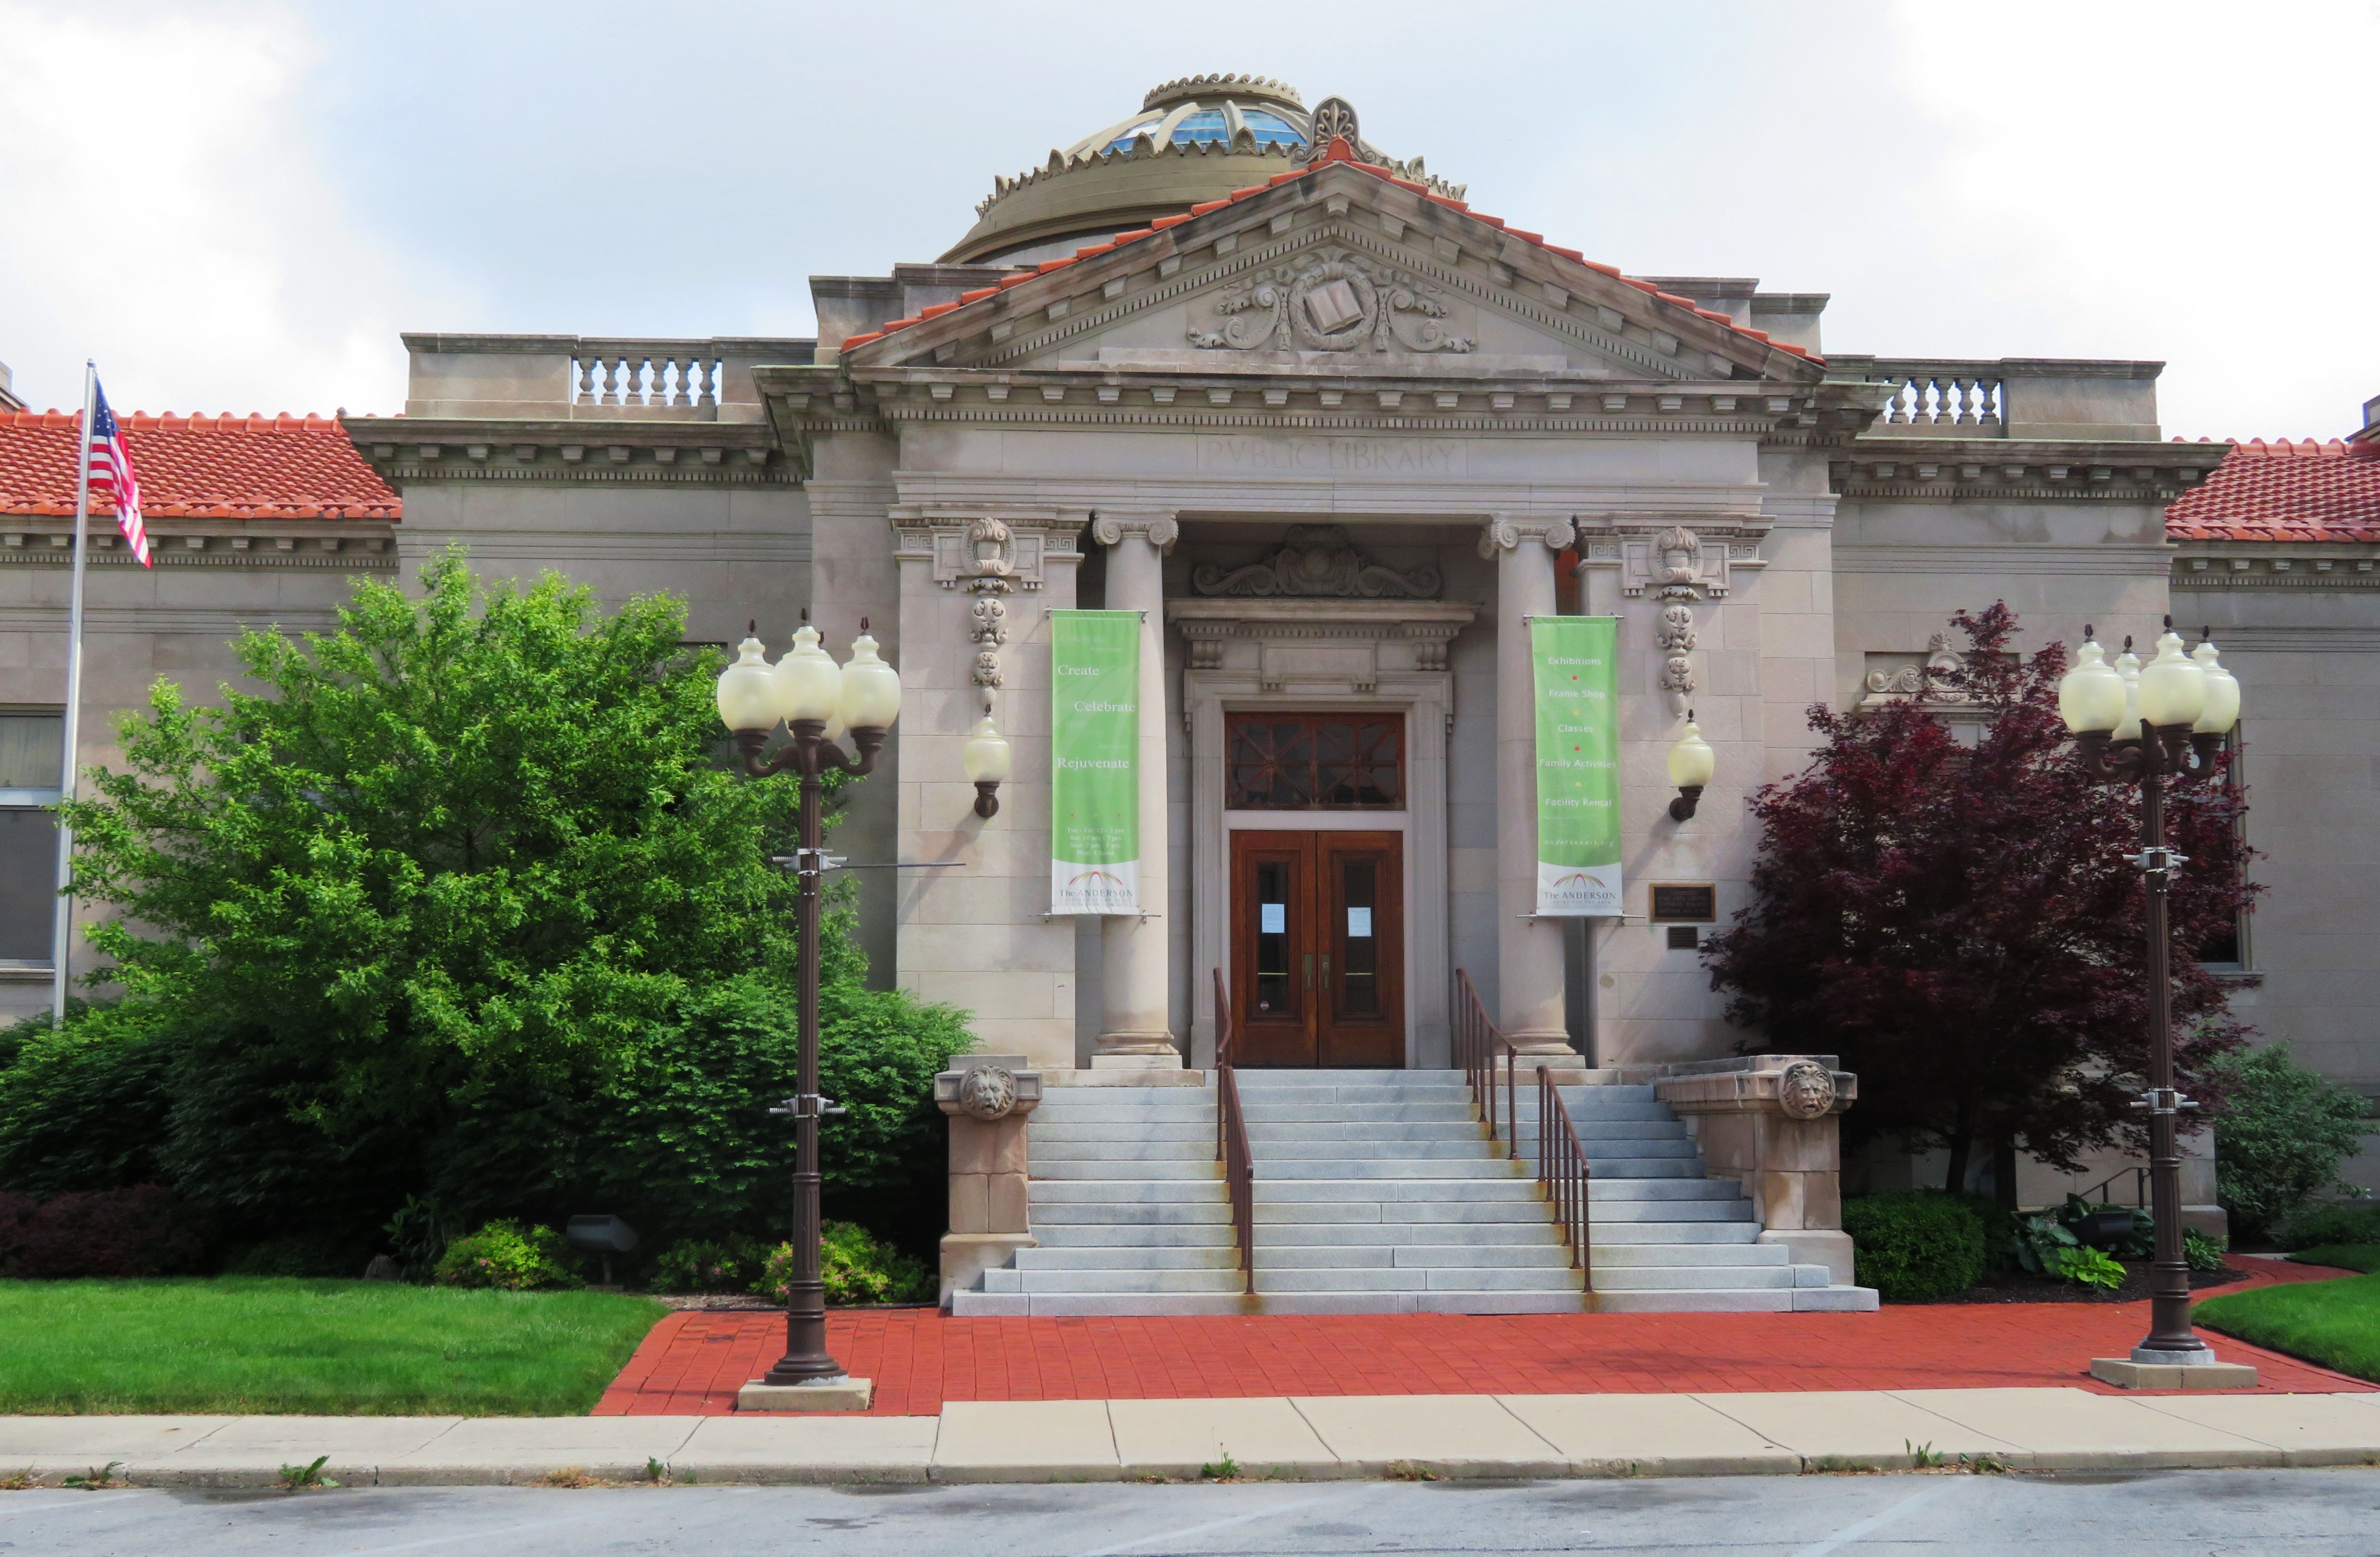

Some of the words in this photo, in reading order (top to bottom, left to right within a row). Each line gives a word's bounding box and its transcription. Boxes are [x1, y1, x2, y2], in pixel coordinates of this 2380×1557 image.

[1328, 442, 1457, 472] LIBRARY
[1548, 657, 1602, 665] Exhibitions
[1058, 665, 1100, 675] Create
[1549, 689, 1579, 697] Frame
[1582, 689, 1606, 699] Shop
[1074, 700, 1136, 712] Celebrate
[1557, 724, 1594, 733] Classes
[1057, 757, 1130, 771] Rejuvenate
[1540, 759, 1571, 768] Family
[1574, 759, 1617, 768] Activities
[1546, 798, 1580, 808] Facility
[1582, 798, 1612, 807] Rental
[1544, 839, 1614, 847] andersonart.org
[1077, 889, 1133, 897] ANDERSON
[1562, 892, 1616, 900] ANDERSON
